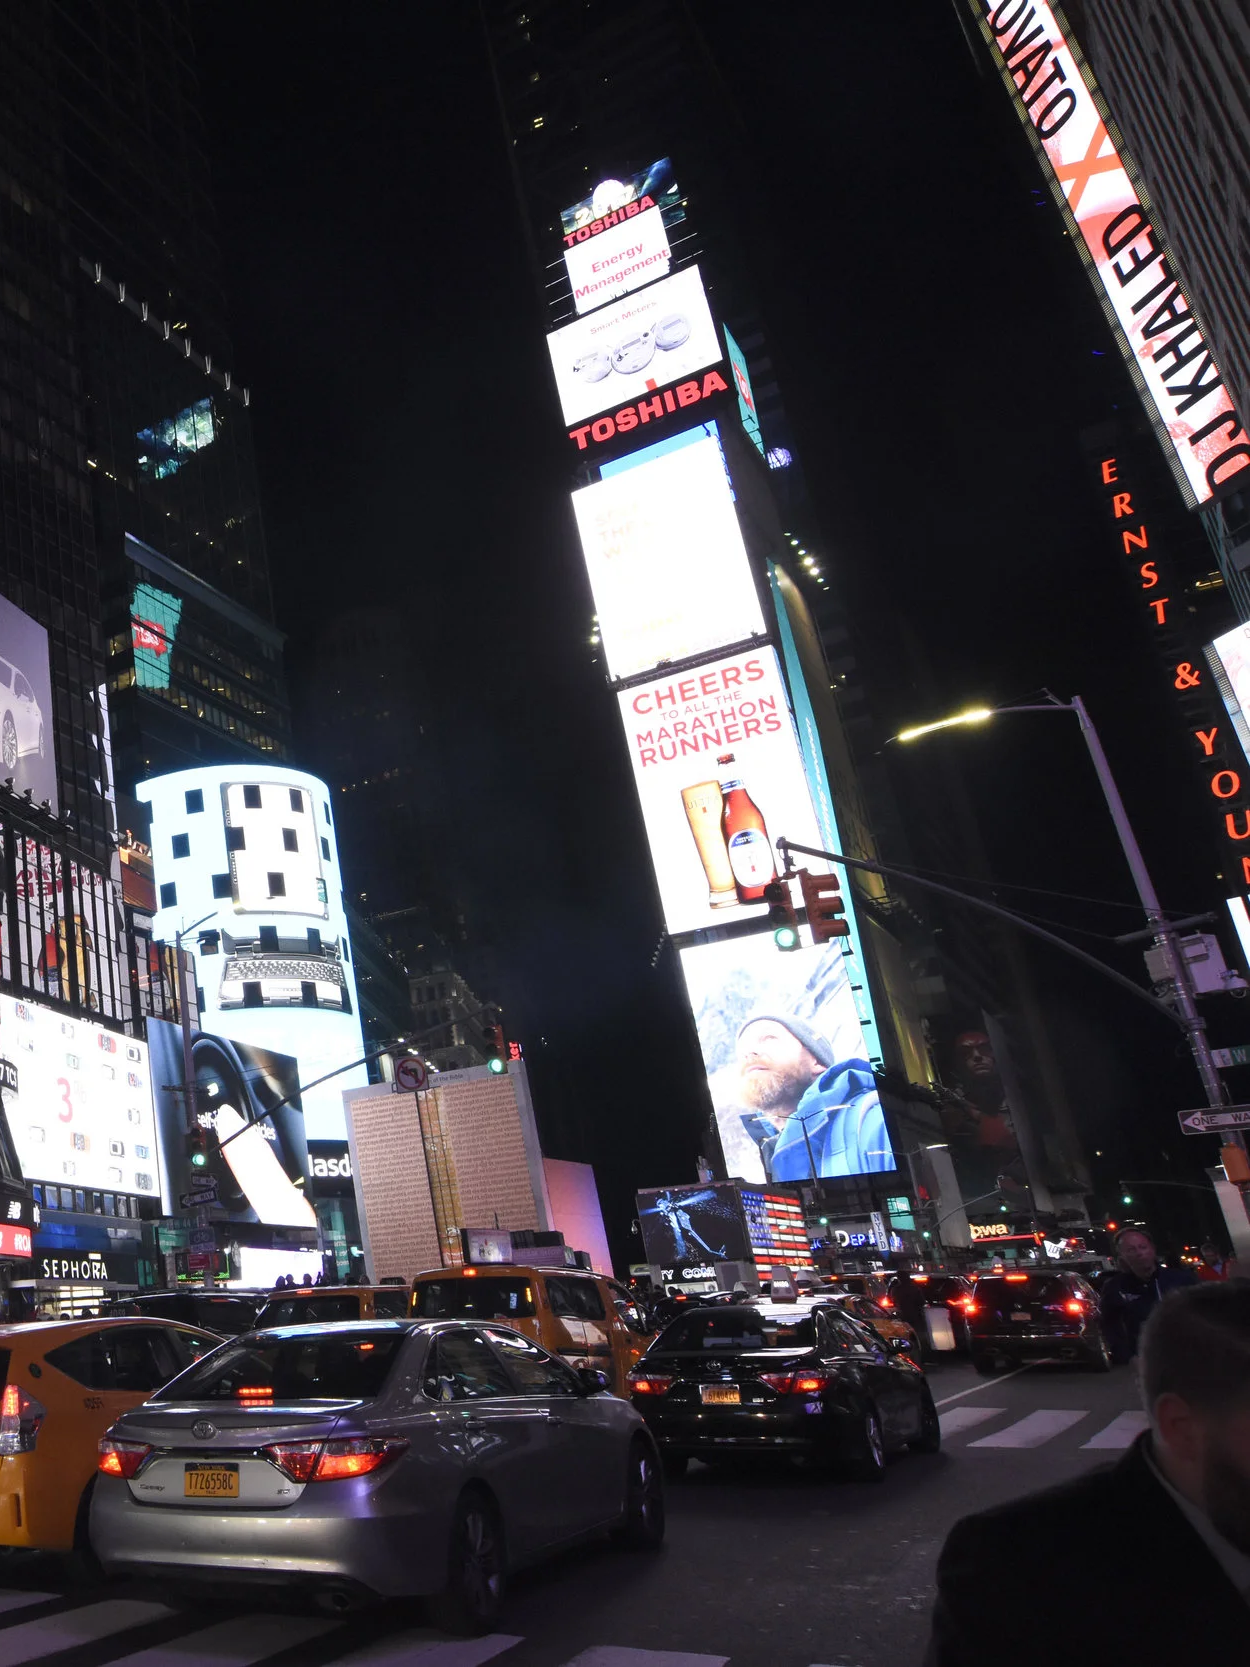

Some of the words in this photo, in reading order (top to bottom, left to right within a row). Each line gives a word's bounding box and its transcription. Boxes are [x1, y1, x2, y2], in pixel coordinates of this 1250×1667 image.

[563, 195, 655, 248] TOSHIBA
[575, 249, 670, 300] Management
[591, 243, 643, 274] Energy
[568, 370, 728, 451] TOSHIBA
[1101, 458, 1169, 625] ERNST
[1174, 662, 1200, 690] &
[632, 658, 765, 716] CHEERS
[660, 707, 680, 721] TO
[684, 699, 711, 717] ALL
[714, 690, 743, 708] THE
[636, 694, 777, 749] MARATHON
[639, 712, 783, 768] RUNNERS
[1192, 1115, 1219, 1127] ONE
[872, 1213, 888, 1250] NYPD
[42, 1258, 109, 1280] SEPHORA
[188, 1472, 234, 1490] T726558C
